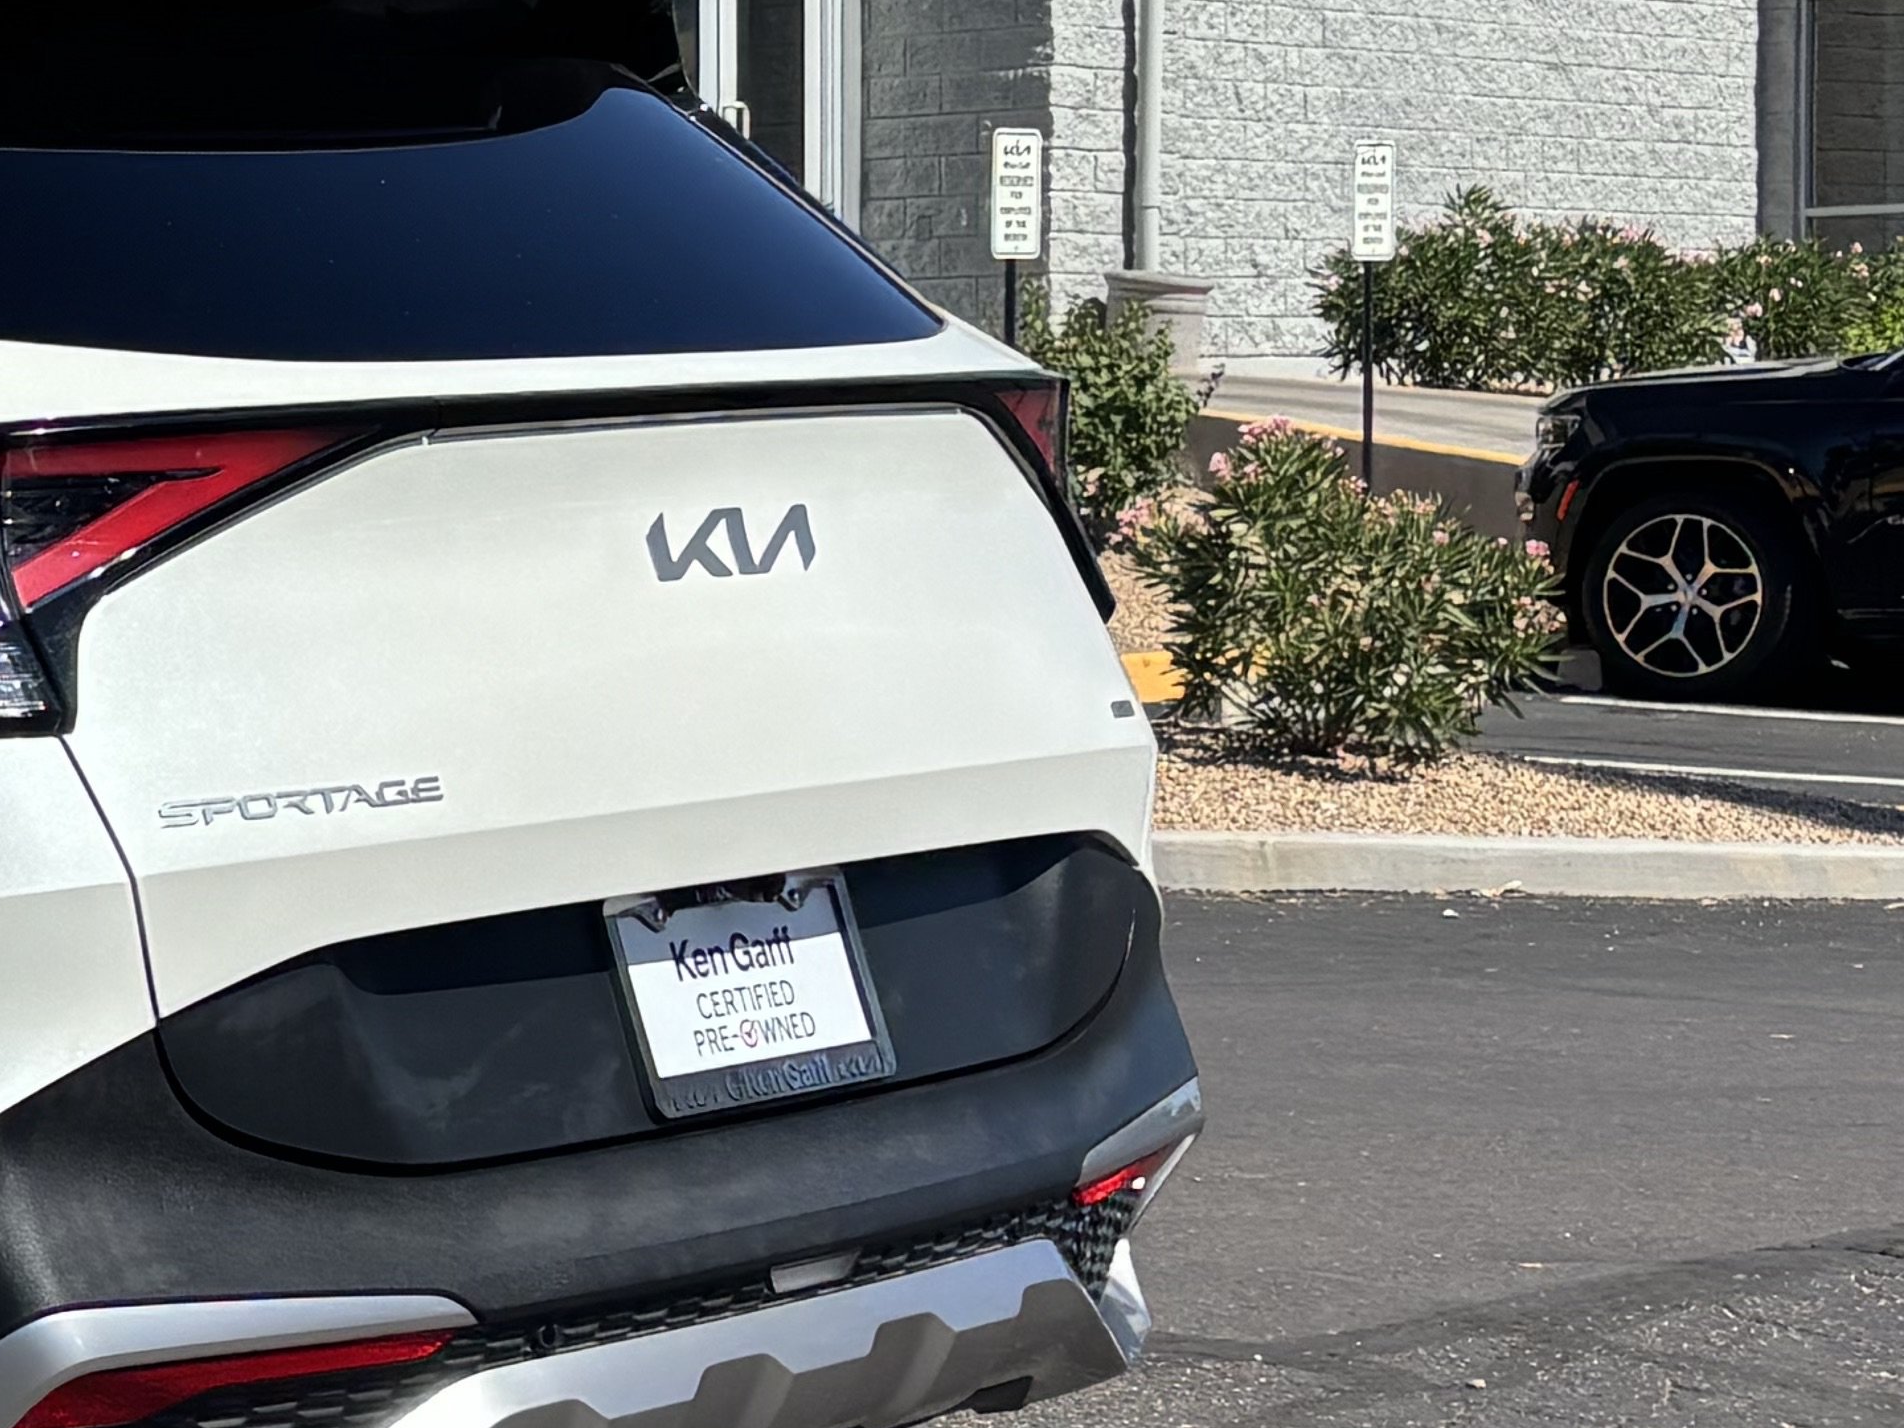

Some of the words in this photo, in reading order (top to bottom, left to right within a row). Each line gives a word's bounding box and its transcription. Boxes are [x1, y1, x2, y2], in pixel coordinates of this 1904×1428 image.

[645, 503, 816, 582] KIA
[158, 776, 444, 829] SPORTAGE
[669, 938, 728, 982] Ken
[729, 925, 795, 972] Garff
[696, 979, 796, 1021] CERTIFIED
[693, 1011, 816, 1057] PRE-OWNED
